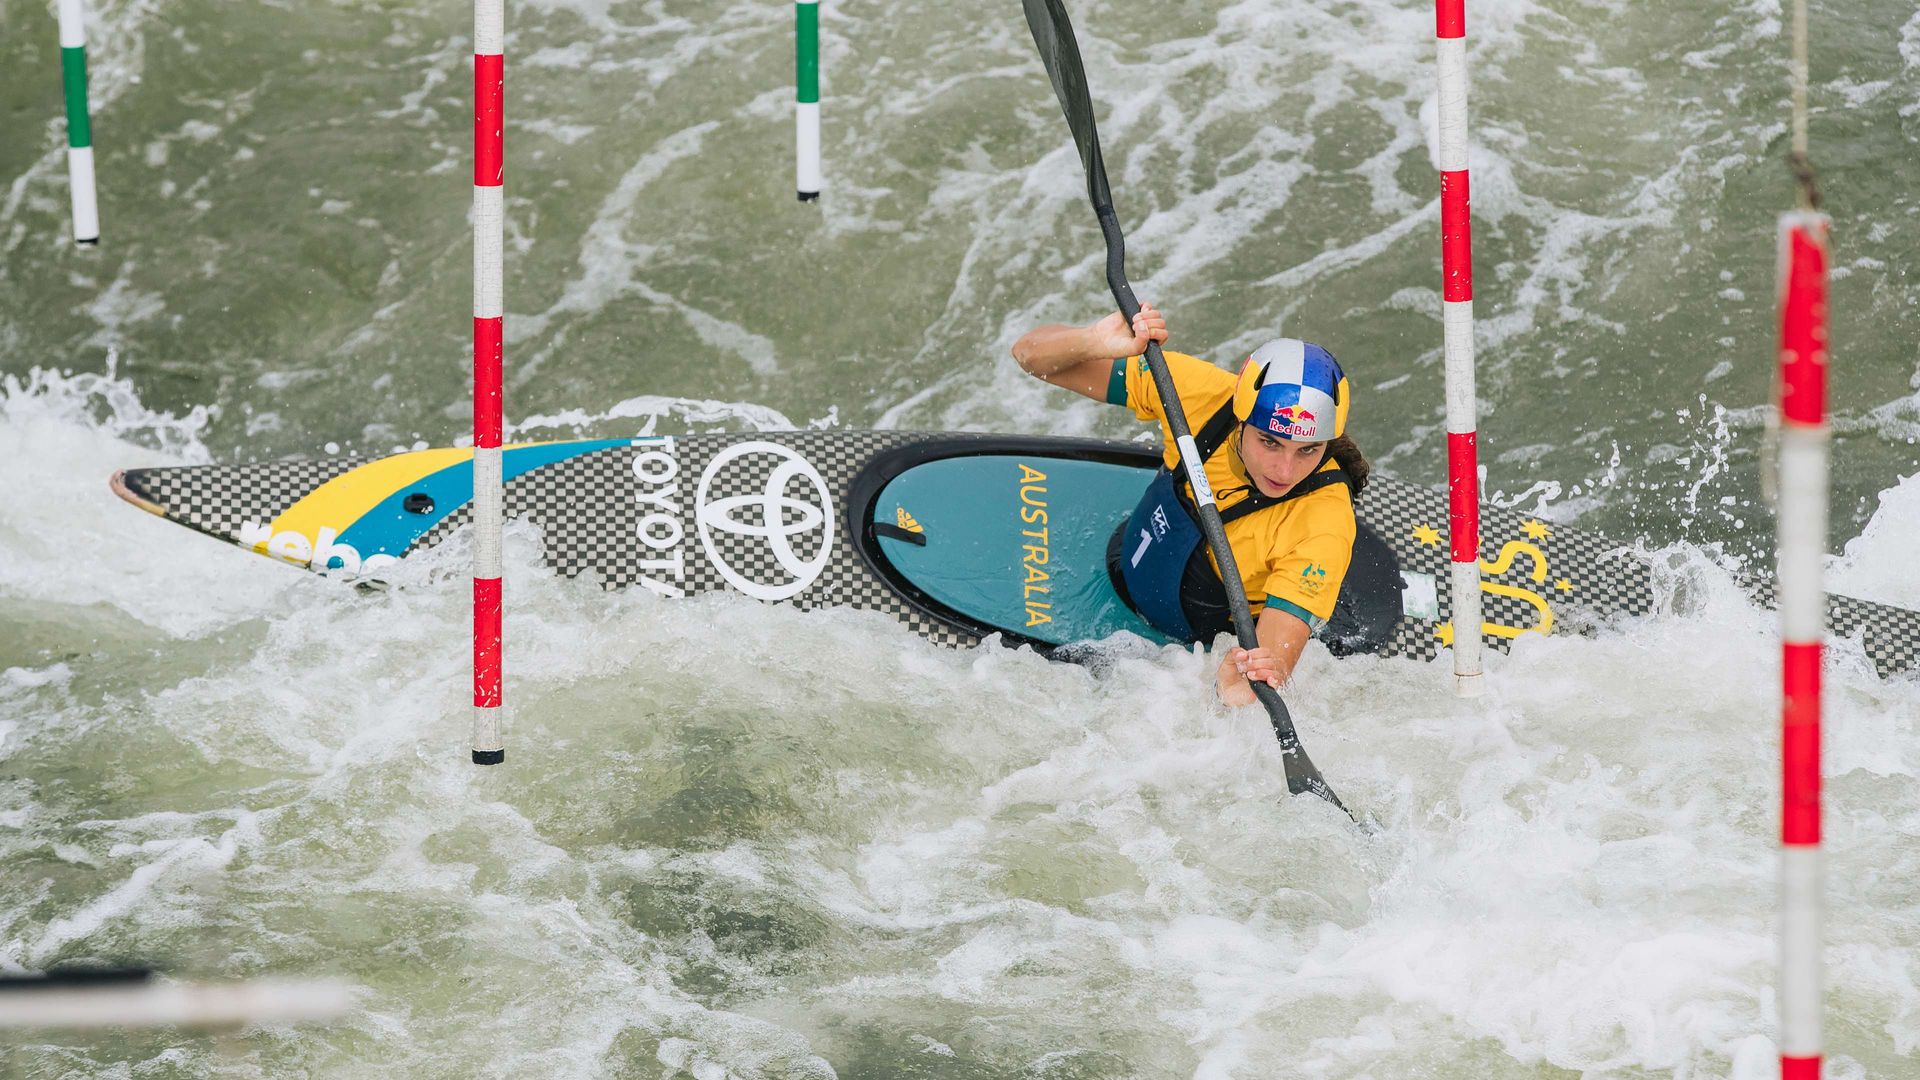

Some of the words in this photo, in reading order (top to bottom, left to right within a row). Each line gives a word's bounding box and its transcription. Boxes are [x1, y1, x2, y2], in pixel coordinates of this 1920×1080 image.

[1269, 418, 1294, 435] Red
[1294, 425, 1317, 438] Bull
[1018, 463, 1053, 627] AUSTRALIA
[1130, 528, 1153, 569] 1
